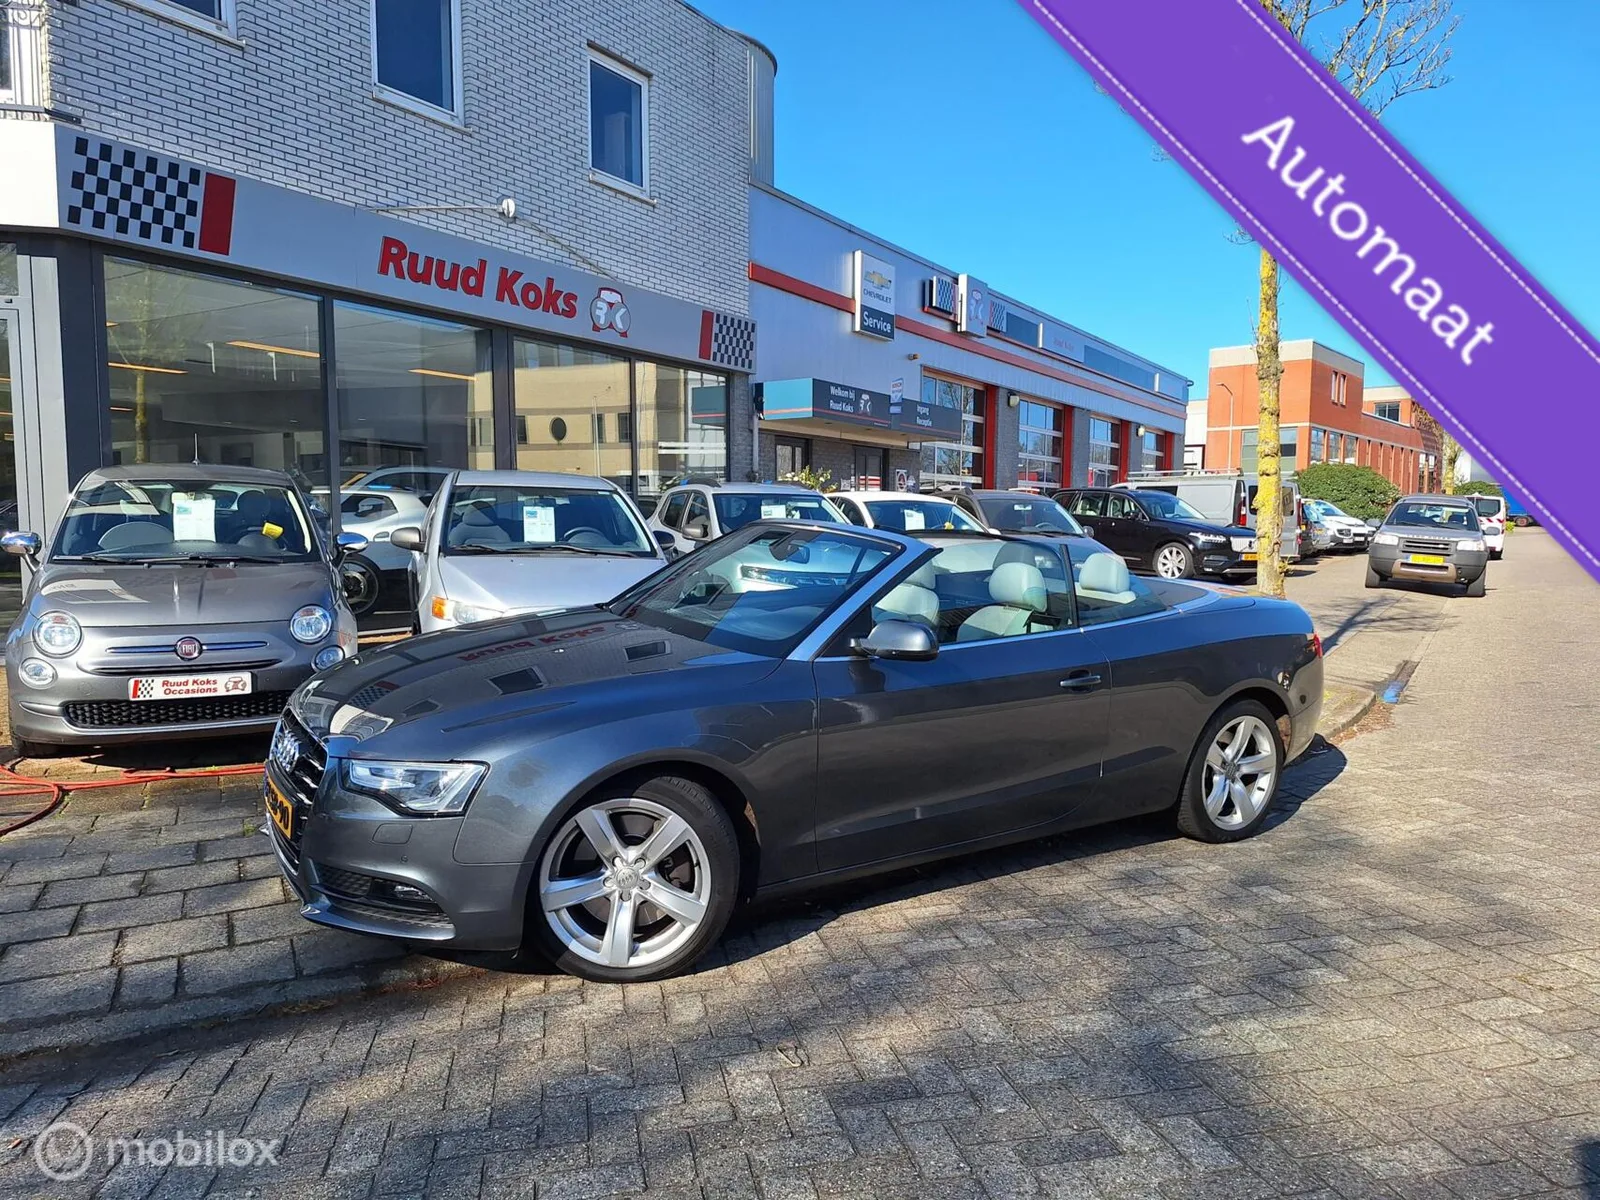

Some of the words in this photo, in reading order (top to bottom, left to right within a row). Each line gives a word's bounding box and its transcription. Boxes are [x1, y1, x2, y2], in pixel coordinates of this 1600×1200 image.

[377, 236, 487, 297] Ruud
[496, 266, 578, 319] Koks
[863, 288, 891, 303] CHEVROLET
[863, 311, 891, 333] Service
[830, 385, 848, 398] Welkom
[830, 400, 842, 411] Ruud
[842, 401, 854, 413] Koks
[182, 644, 196, 654] FIAT
[162, 679, 189, 687] Ruud
[192, 678, 218, 687] Koks
[163, 686, 218, 695] Occasions
